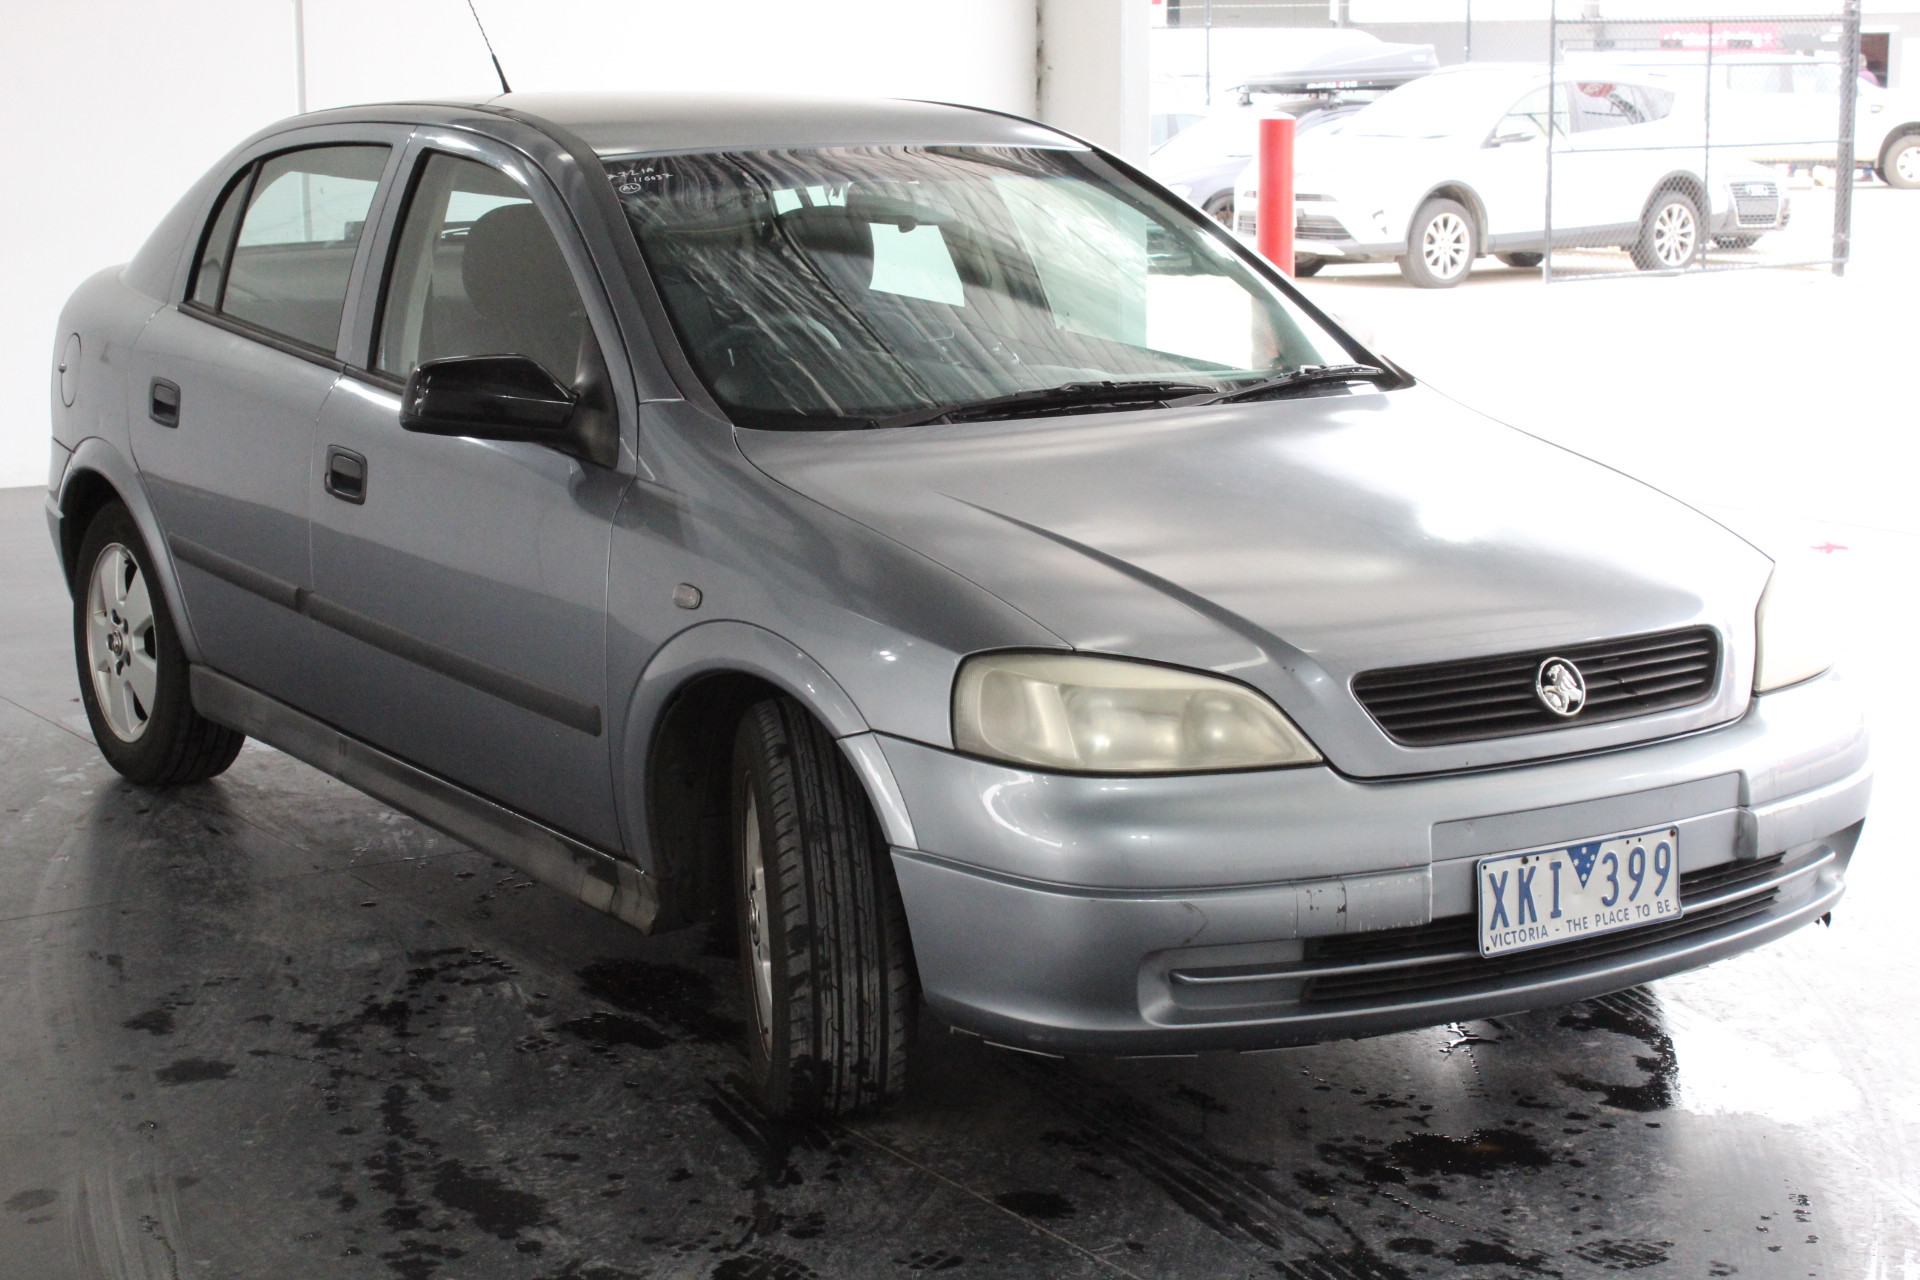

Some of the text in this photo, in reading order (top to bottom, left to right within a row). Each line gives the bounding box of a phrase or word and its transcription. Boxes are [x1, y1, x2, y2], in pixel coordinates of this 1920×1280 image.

[1488, 840, 1671, 931] XKI 399
[1490, 924, 1549, 948] VICTORIA
[1566, 918, 1589, 933] THE
[1595, 908, 1630, 928] PLACE
[1635, 904, 1650, 918] TO
[1656, 899, 1671, 914] BE
